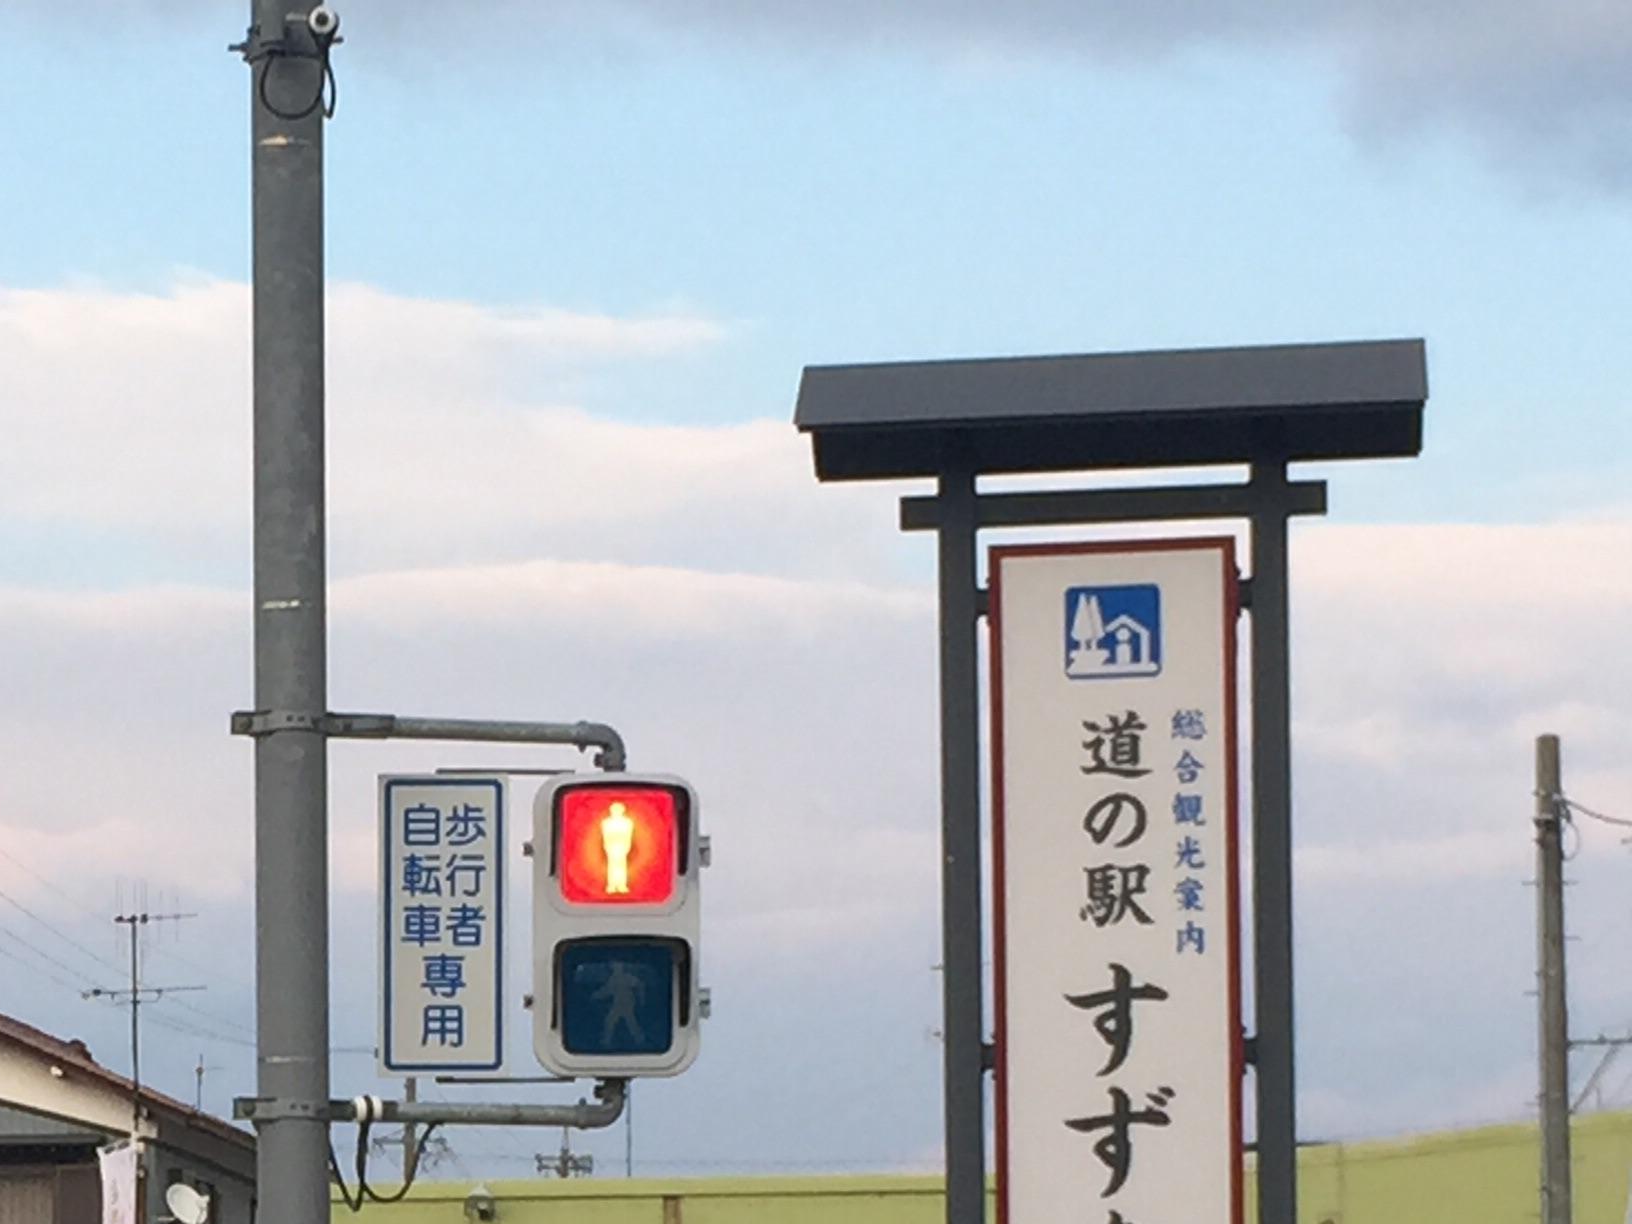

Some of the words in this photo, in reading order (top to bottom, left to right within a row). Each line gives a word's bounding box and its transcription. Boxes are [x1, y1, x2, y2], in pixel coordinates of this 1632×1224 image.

[401, 803, 441, 947] 自転車
[445, 803, 486, 946] 歩行者
[1079, 711, 1155, 928] 道の駅
[1171, 709, 1207, 955] 総合観光案内
[420, 953, 466, 1048] 専用
